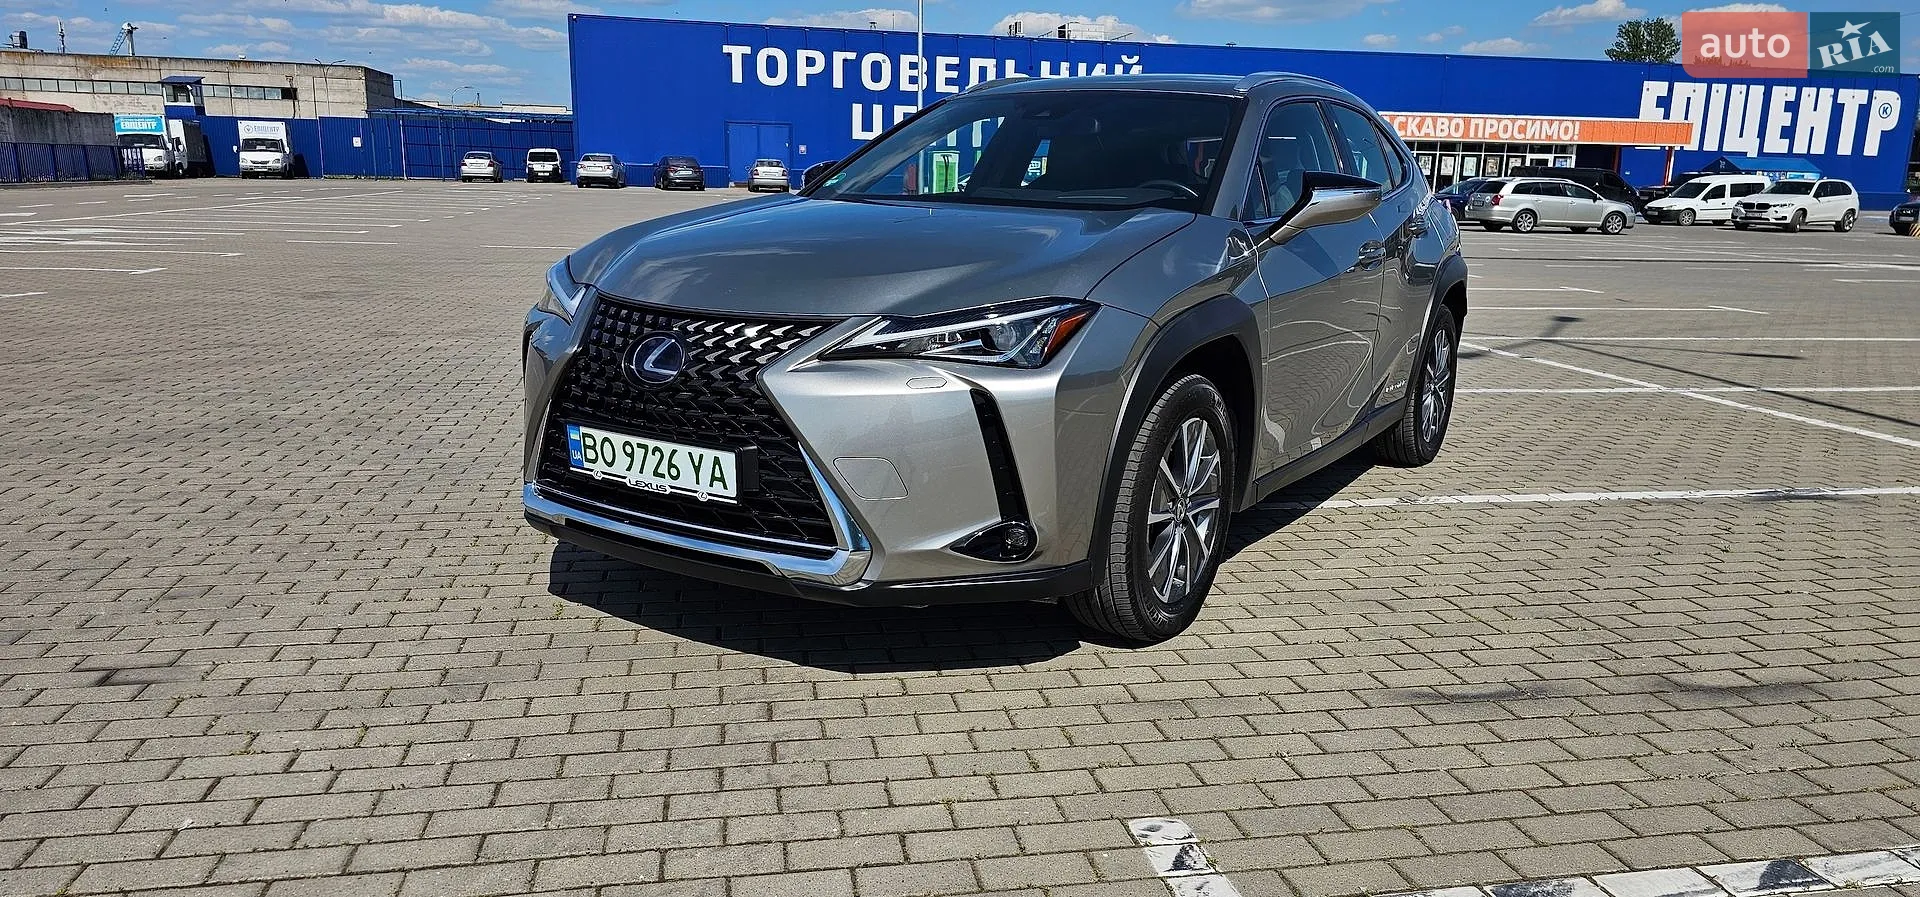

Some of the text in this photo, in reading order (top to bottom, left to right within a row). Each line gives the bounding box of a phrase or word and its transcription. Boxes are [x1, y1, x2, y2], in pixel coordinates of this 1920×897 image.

[1382, 115, 1580, 141] СКАВО ПРОСИМО!
[1634, 80, 1901, 158] ЕПІЦЕНТР
[572, 450, 583, 462] UA
[581, 432, 729, 491] BO 9726 YA
[627, 477, 669, 493] LEXUS
